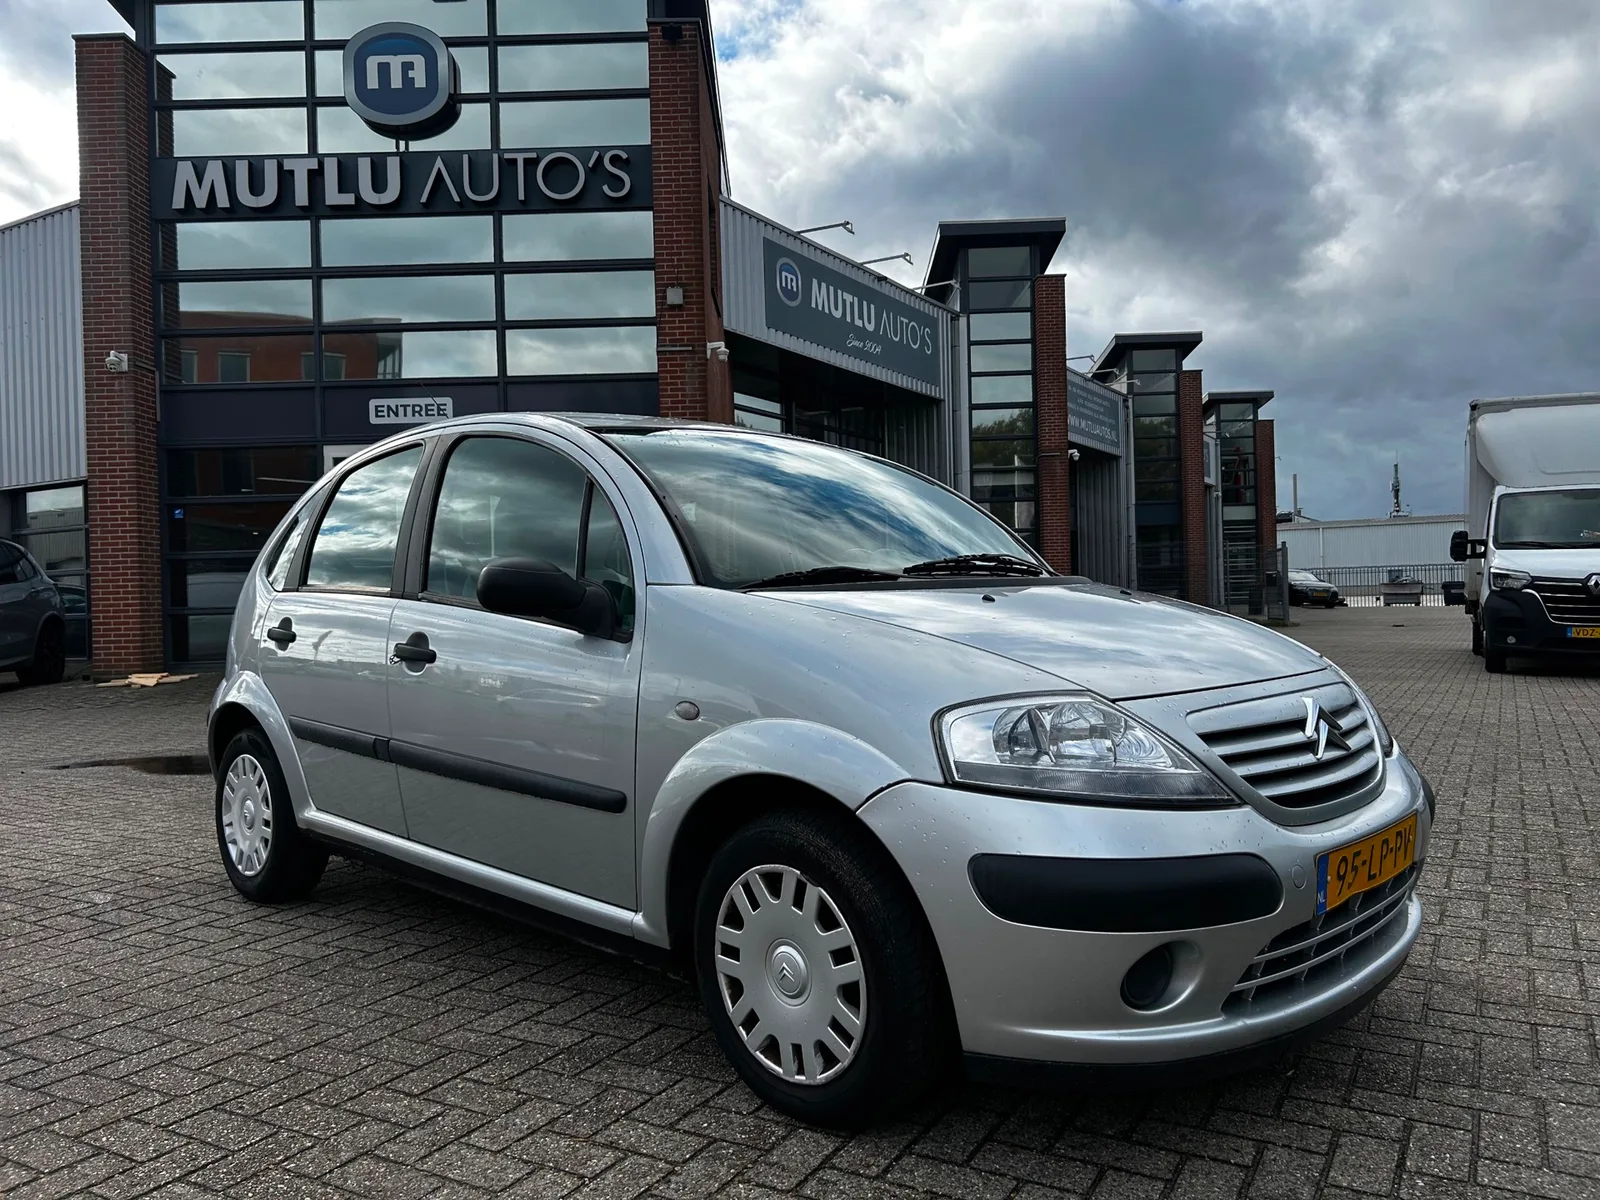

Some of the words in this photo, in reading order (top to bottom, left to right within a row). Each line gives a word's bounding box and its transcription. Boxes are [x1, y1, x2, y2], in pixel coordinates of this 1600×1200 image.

[172, 156, 401, 209] MUTLU
[419, 149, 632, 203] AUTO'S
[811, 278, 875, 332] MUTLU
[879, 308, 932, 355] AUTO'S
[1337, 823, 1413, 897] 95-LP-PV
[1317, 891, 1326, 905] NL
